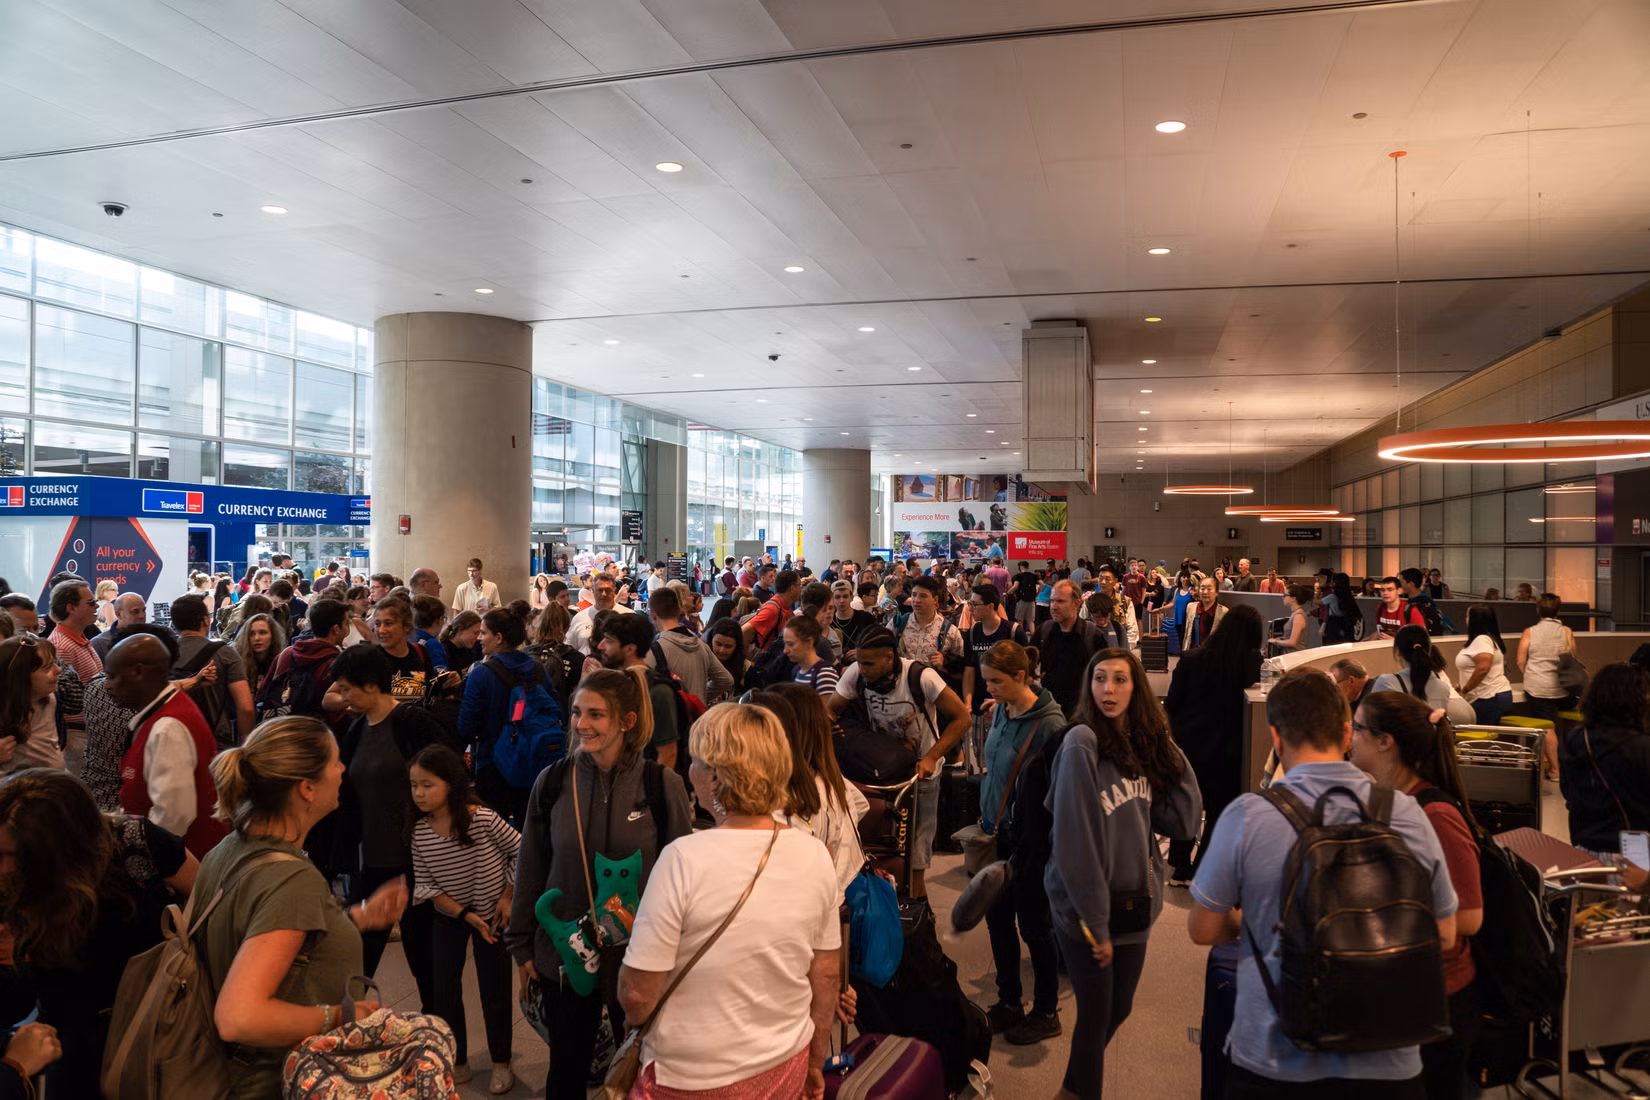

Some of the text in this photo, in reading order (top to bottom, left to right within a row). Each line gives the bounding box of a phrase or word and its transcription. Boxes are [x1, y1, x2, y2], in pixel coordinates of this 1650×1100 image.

[30, 485, 78, 494] CURRENCY
[30, 497, 79, 506] EXCHANGE
[160, 501, 185, 509] Travelex
[218, 503, 327, 519] CURRENCY EXCHANGE
[901, 513, 933, 521] Experience
[96, 546, 136, 559] All your
[95, 562, 140, 572] currency
